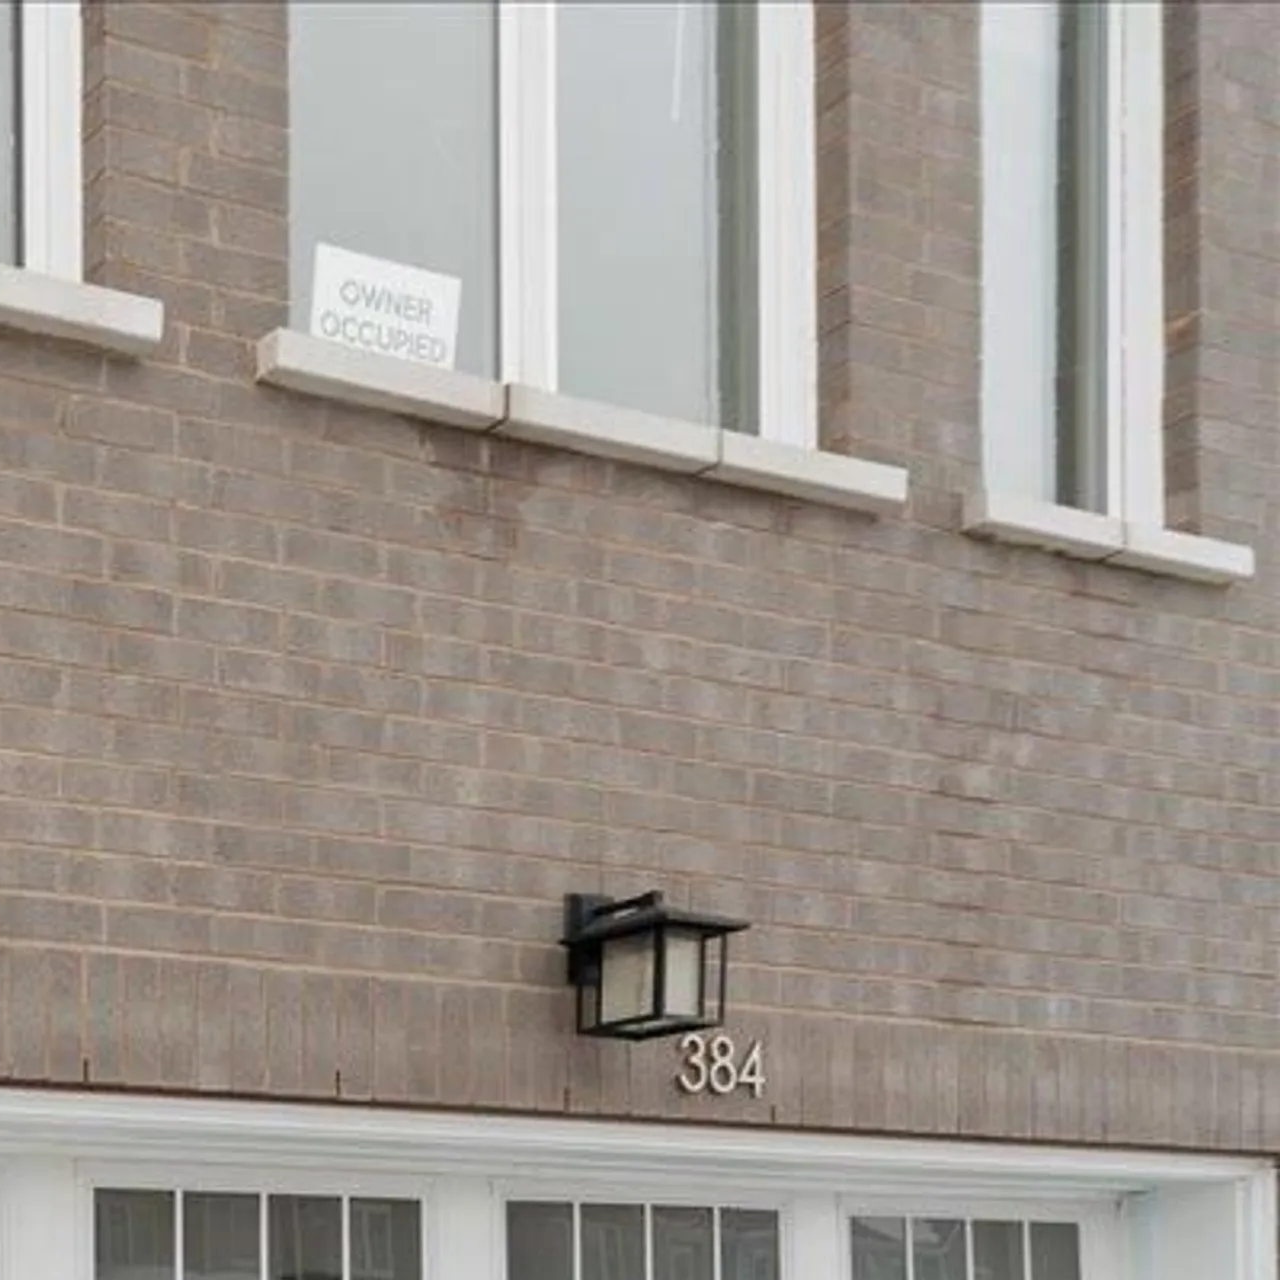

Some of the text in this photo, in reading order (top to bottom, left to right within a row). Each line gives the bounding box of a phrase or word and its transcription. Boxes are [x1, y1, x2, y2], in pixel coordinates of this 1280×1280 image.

[339, 279, 433, 326] OWNER
[321, 310, 447, 362] OCCUPIED
[679, 1033, 766, 1098] 384
